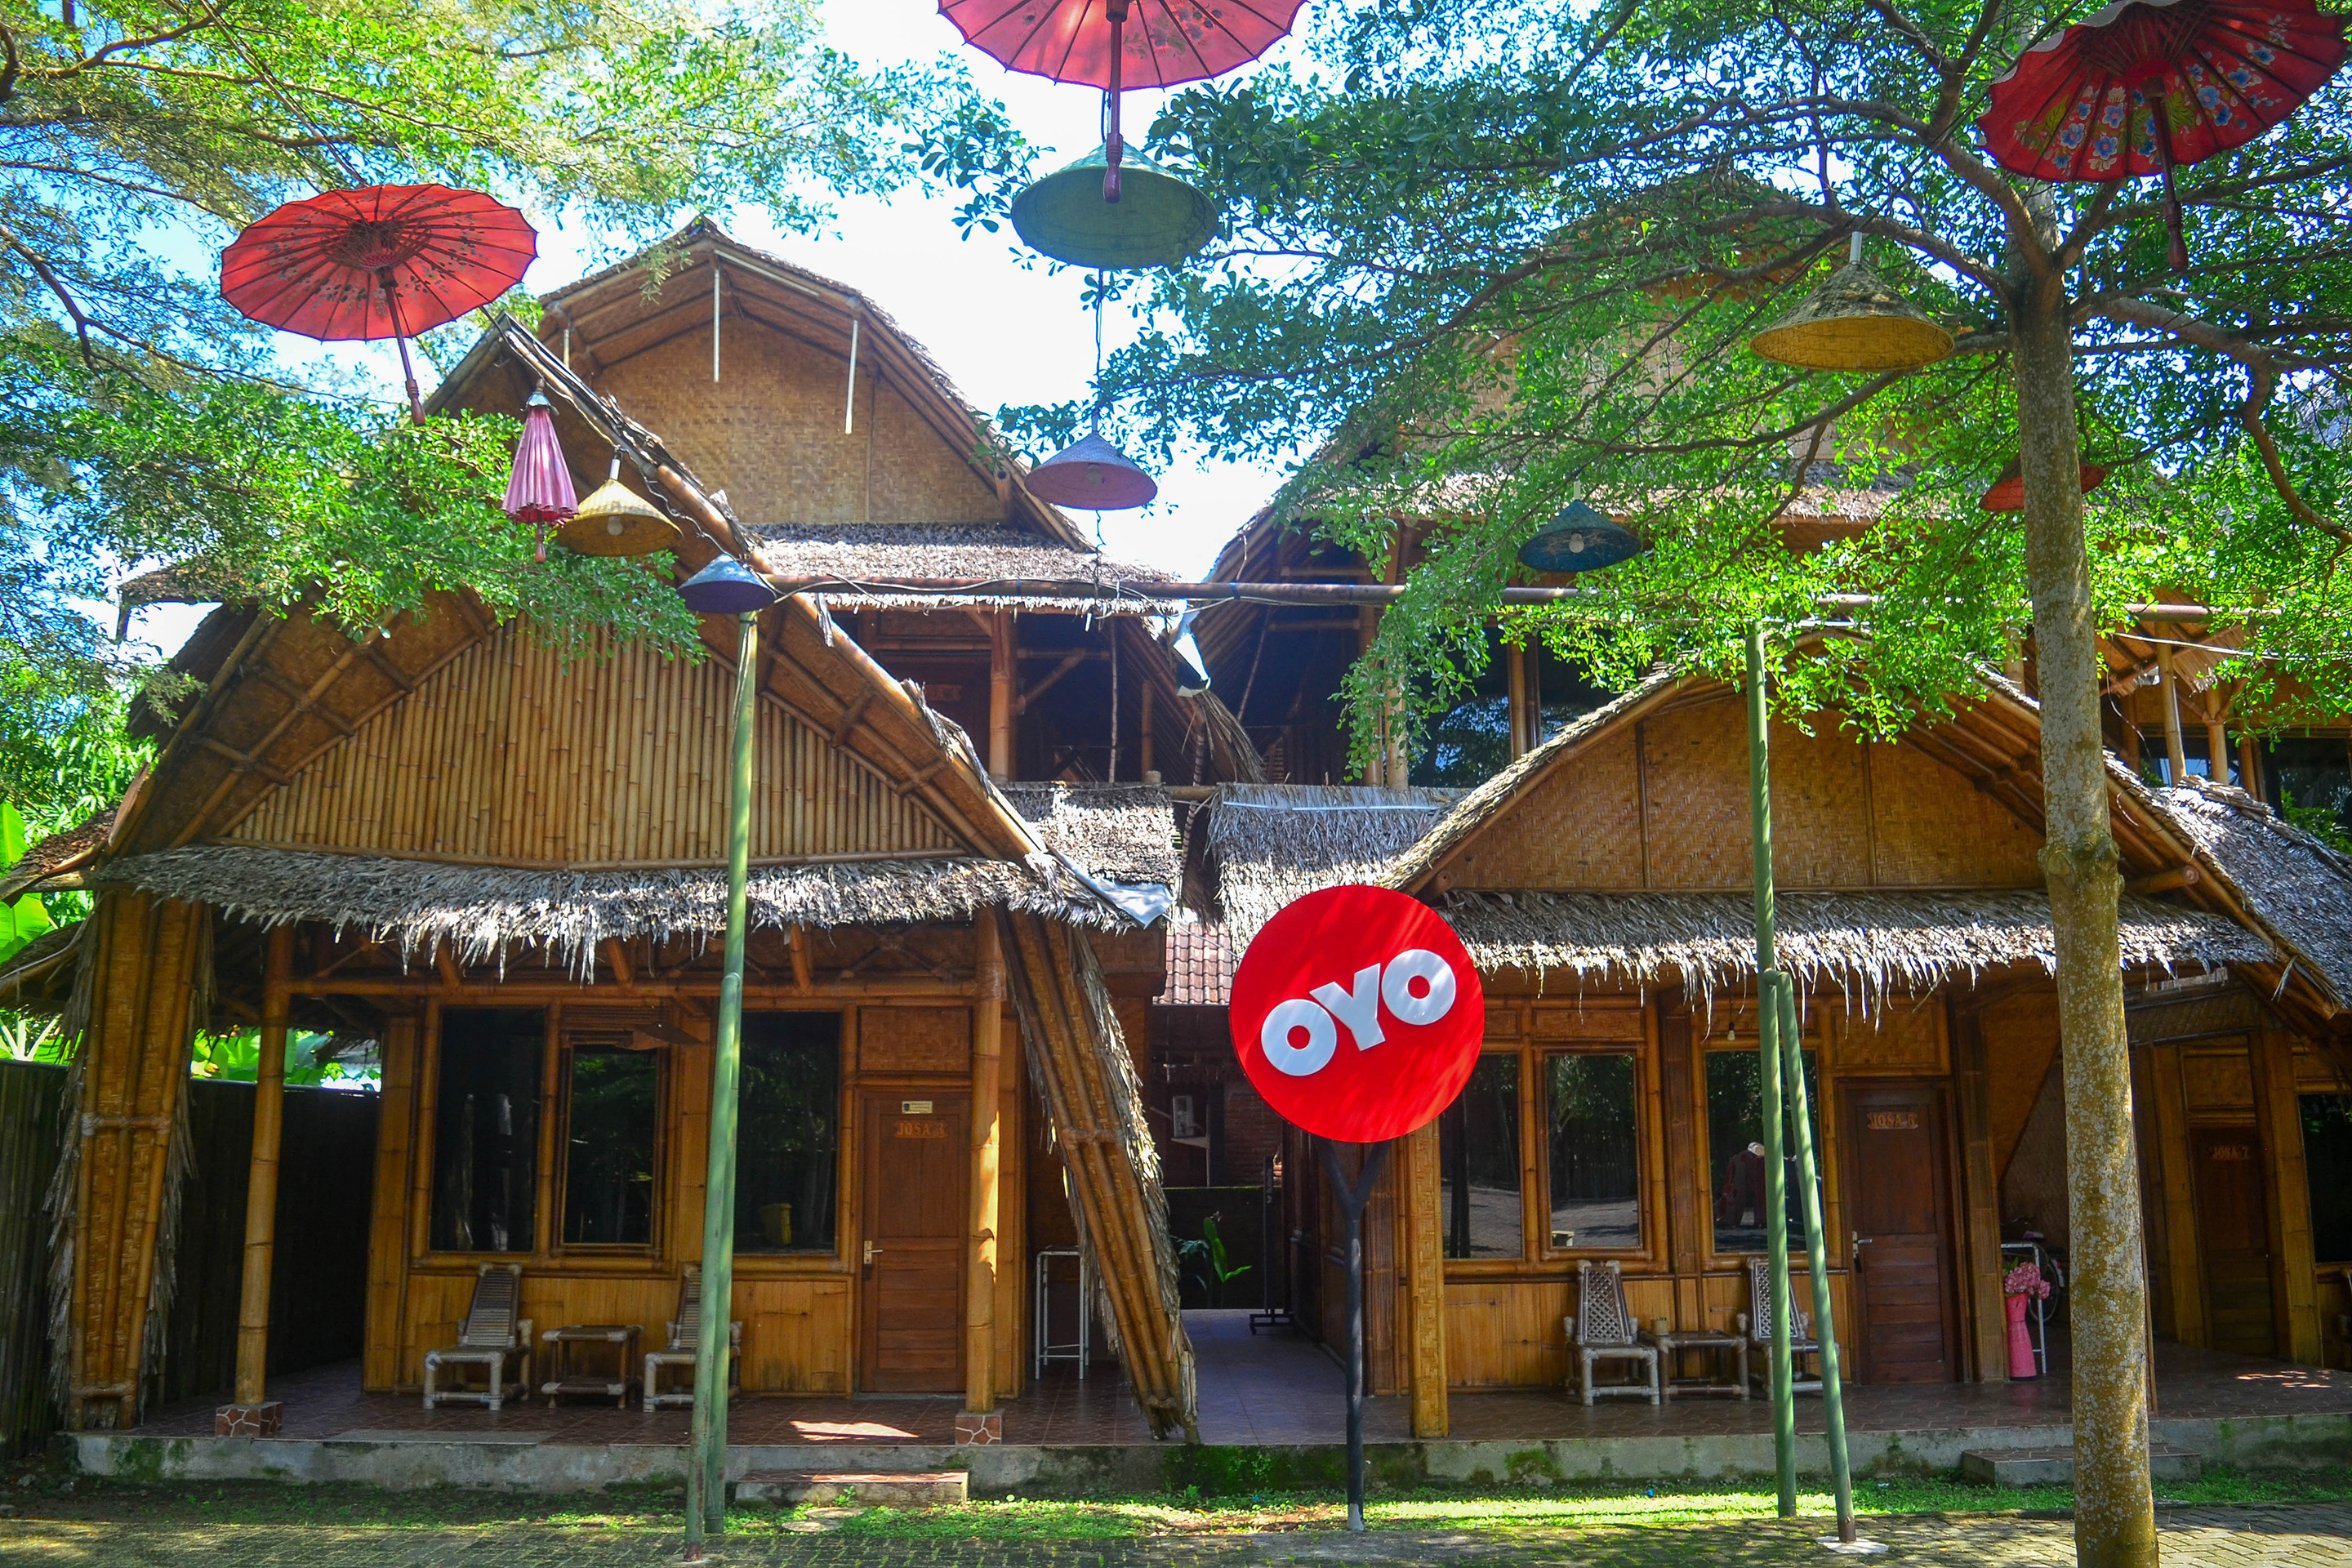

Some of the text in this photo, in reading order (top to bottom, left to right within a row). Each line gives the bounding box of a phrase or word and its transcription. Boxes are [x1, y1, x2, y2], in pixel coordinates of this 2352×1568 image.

[1261, 949, 1456, 1076] OYO
[1870, 1112, 1901, 1126] JOSA
[897, 1122, 931, 1135] JOSA
